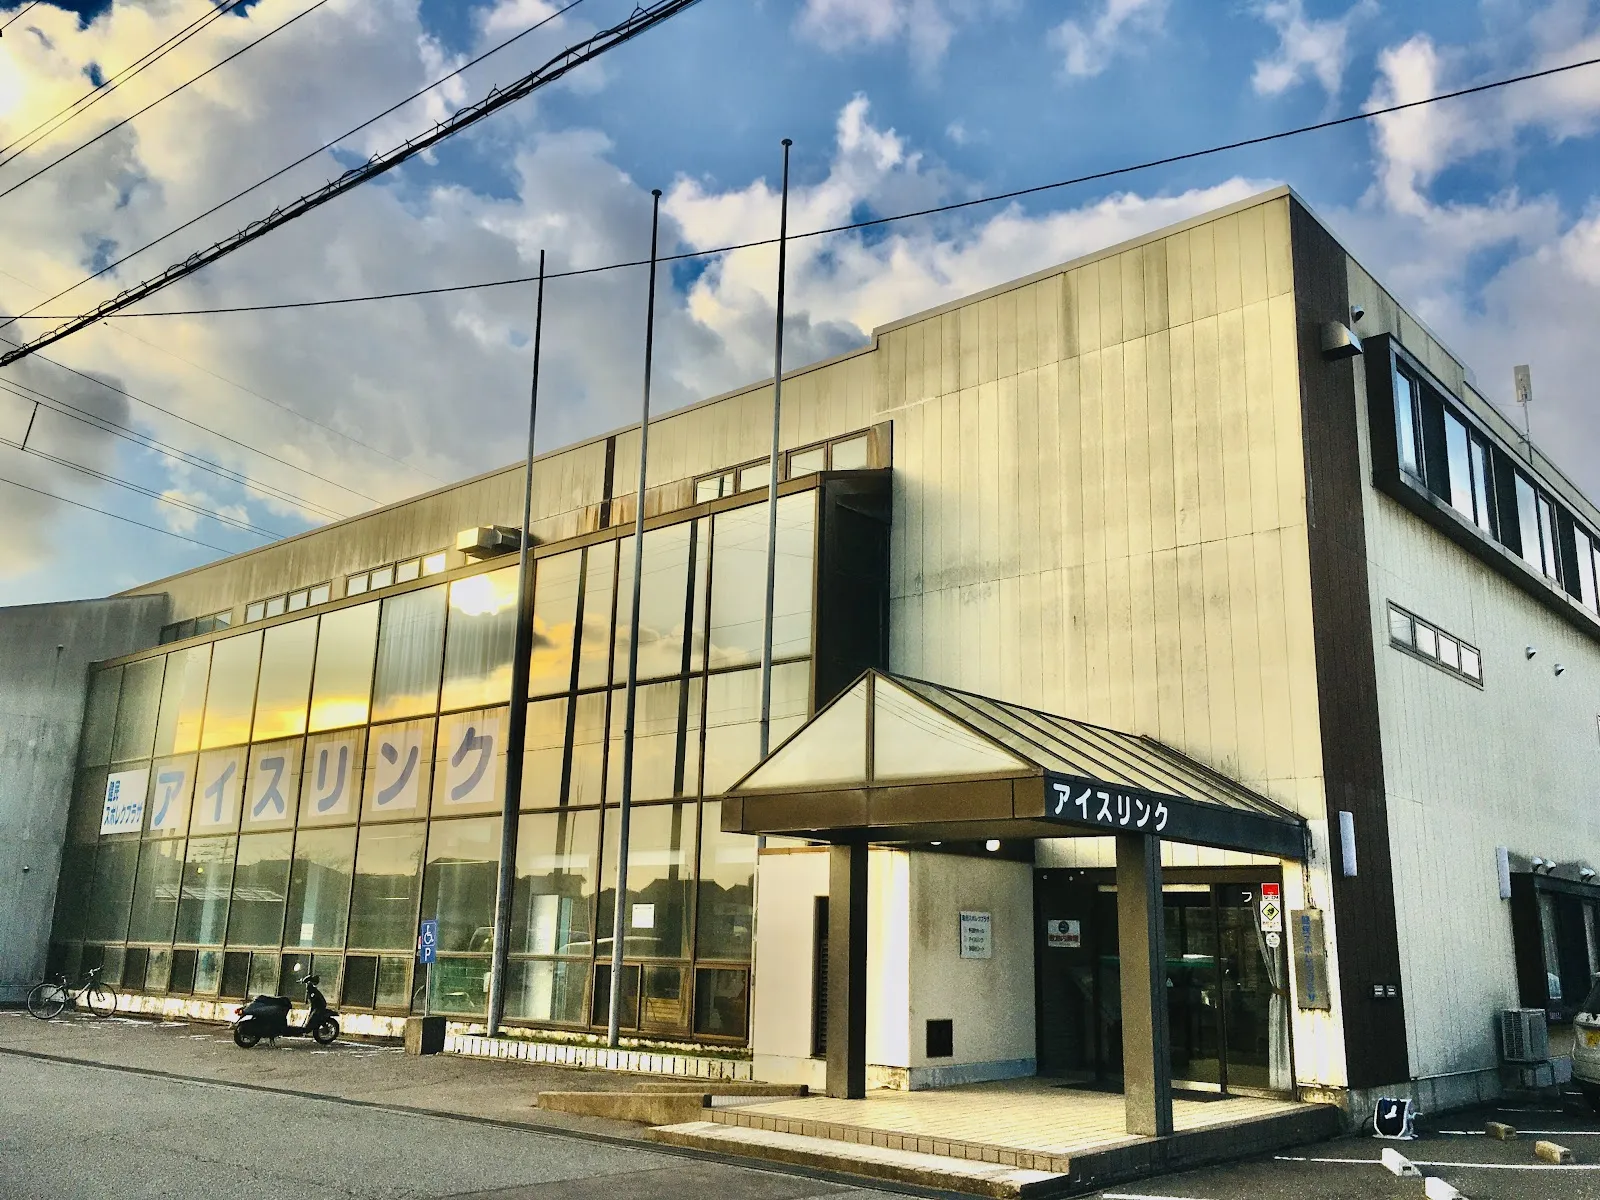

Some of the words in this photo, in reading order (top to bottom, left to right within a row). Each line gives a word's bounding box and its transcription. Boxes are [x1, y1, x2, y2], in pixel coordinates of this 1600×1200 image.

[154, 726, 493, 827] アイスリンク
[1052, 782, 1169, 832] アイスリンク
[424, 947, 432, 962] P
